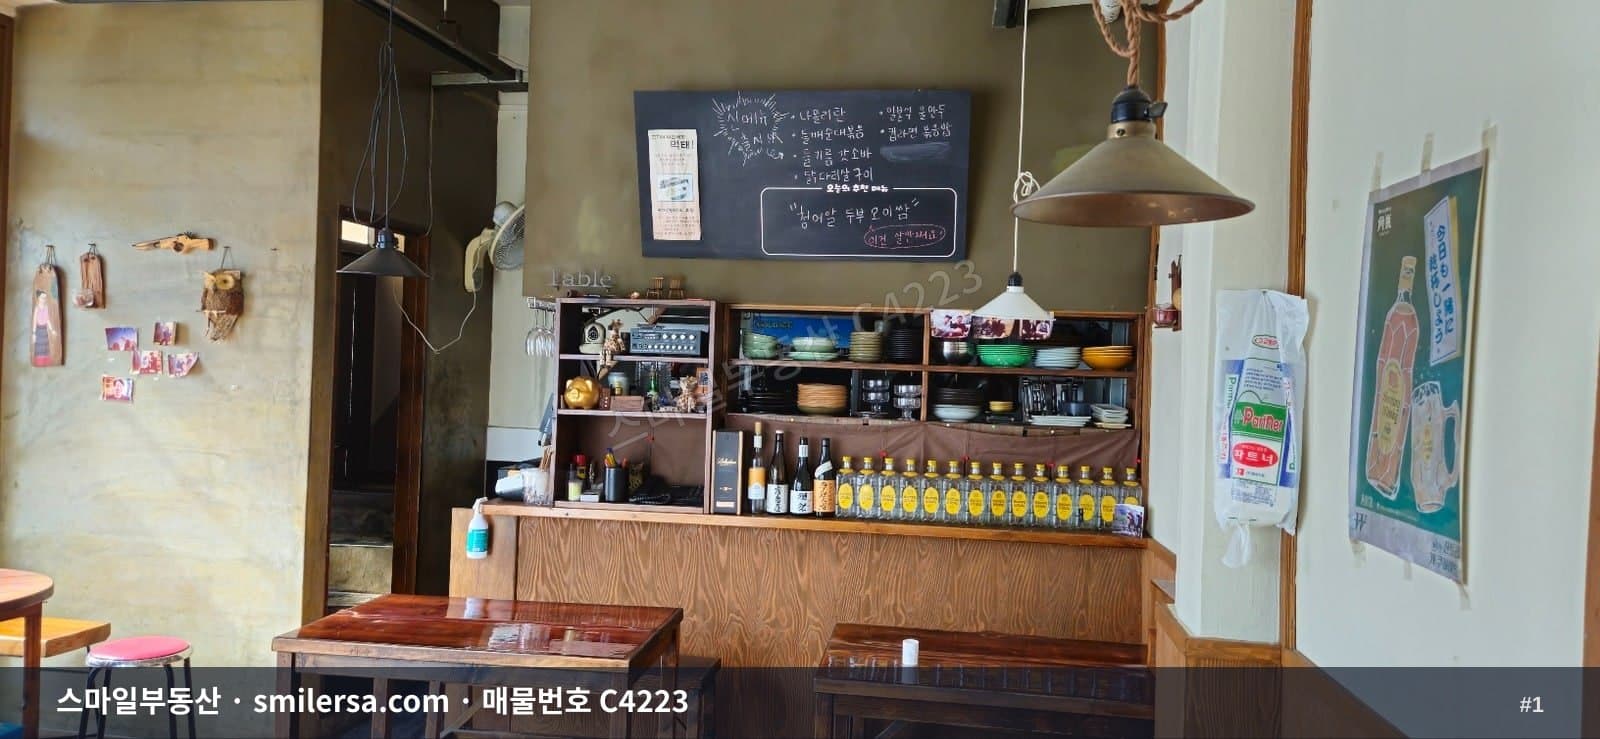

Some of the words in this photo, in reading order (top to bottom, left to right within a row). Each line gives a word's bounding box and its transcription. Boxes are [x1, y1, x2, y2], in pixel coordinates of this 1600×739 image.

[886, 104, 914, 123] 일본식
[918, 103, 947, 121] 물만두
[852, 167, 874, 183] 구이
[826, 184, 850, 194] 오늘의
[871, 185, 889, 193] 메뉴
[845, 208, 865, 225] 두부
[551, 268, 612, 288] Table
[1234, 448, 1273, 465] 파트너
